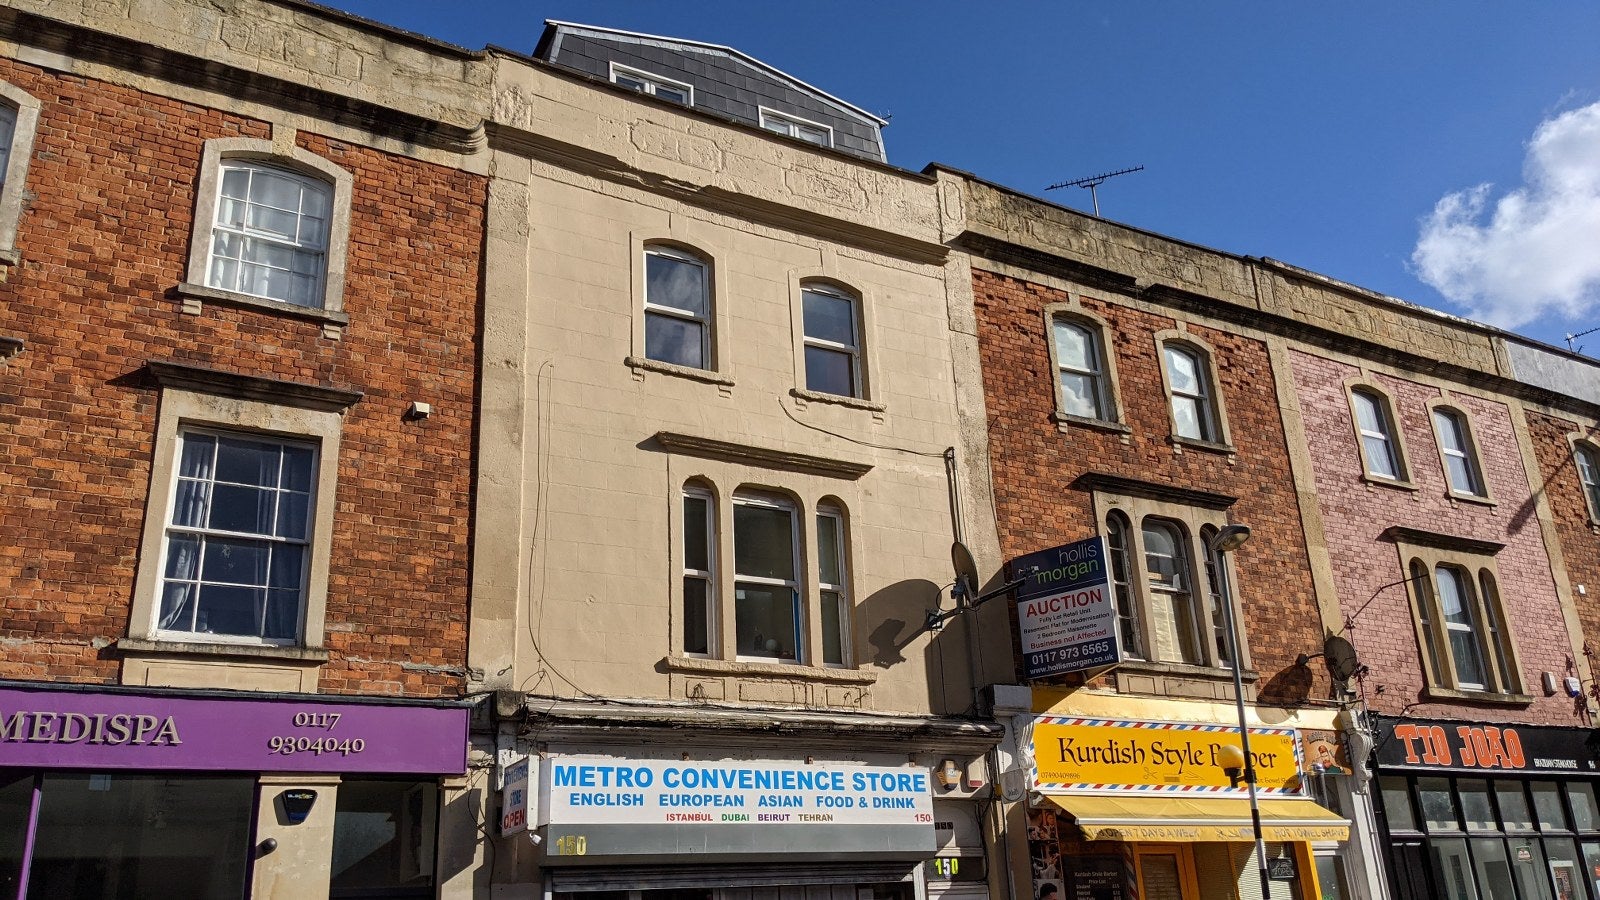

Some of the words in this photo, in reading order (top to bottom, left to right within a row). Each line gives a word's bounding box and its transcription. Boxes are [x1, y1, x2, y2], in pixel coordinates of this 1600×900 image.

[1059, 543, 1097, 564] hollis
[1036, 558, 1099, 584] morgan
[1026, 588, 1102, 618] AUCTION
[1024, 624, 1050, 634] Basement
[1030, 638, 1063, 649] Business
[1077, 629, 1107, 640] Affected
[1032, 652, 1056, 665] 0117
[1060, 647, 1080, 659] 973
[1082, 641, 1109, 656] 6565
[1030, 653, 1114, 675] www.hollismorgan.co.uk
[0, 711, 183, 744] MEDISPA
[295, 712, 341, 730] 0117
[271, 736, 365, 755] 9304040
[1393, 724, 1452, 766] TIO
[1057, 737, 1146, 766] Kurdish
[1152, 741, 1204, 774] Style
[554, 765, 653, 788] METRO
[663, 768, 845, 790] CONVENIENCE
[853, 772, 926, 792] STORE
[570, 793, 644, 806] ENGLISH
[659, 794, 744, 806] EUROPEAN
[758, 795, 803, 807] ASIAN
[816, 796, 854, 808] FOOD
[858, 797, 868, 808] &
[873, 797, 915, 809] DRINK
[504, 809, 525, 829] OPEN
[798, 814, 833, 822] TEHRAN
[914, 814, 931, 822] 150
[1108, 828, 1132, 837] OPEN
[1134, 828, 1139, 837] 7
[1141, 828, 1164, 837] DAYS
[1166, 829, 1173, 837] A
[1174, 829, 1200, 837] WEEK
[1274, 828, 1290, 837] HOT
[1294, 828, 1320, 837] TOWEL
[1322, 829, 1346, 837] SHAVE
[557, 836, 586, 855] 150
[935, 858, 958, 875] 150
